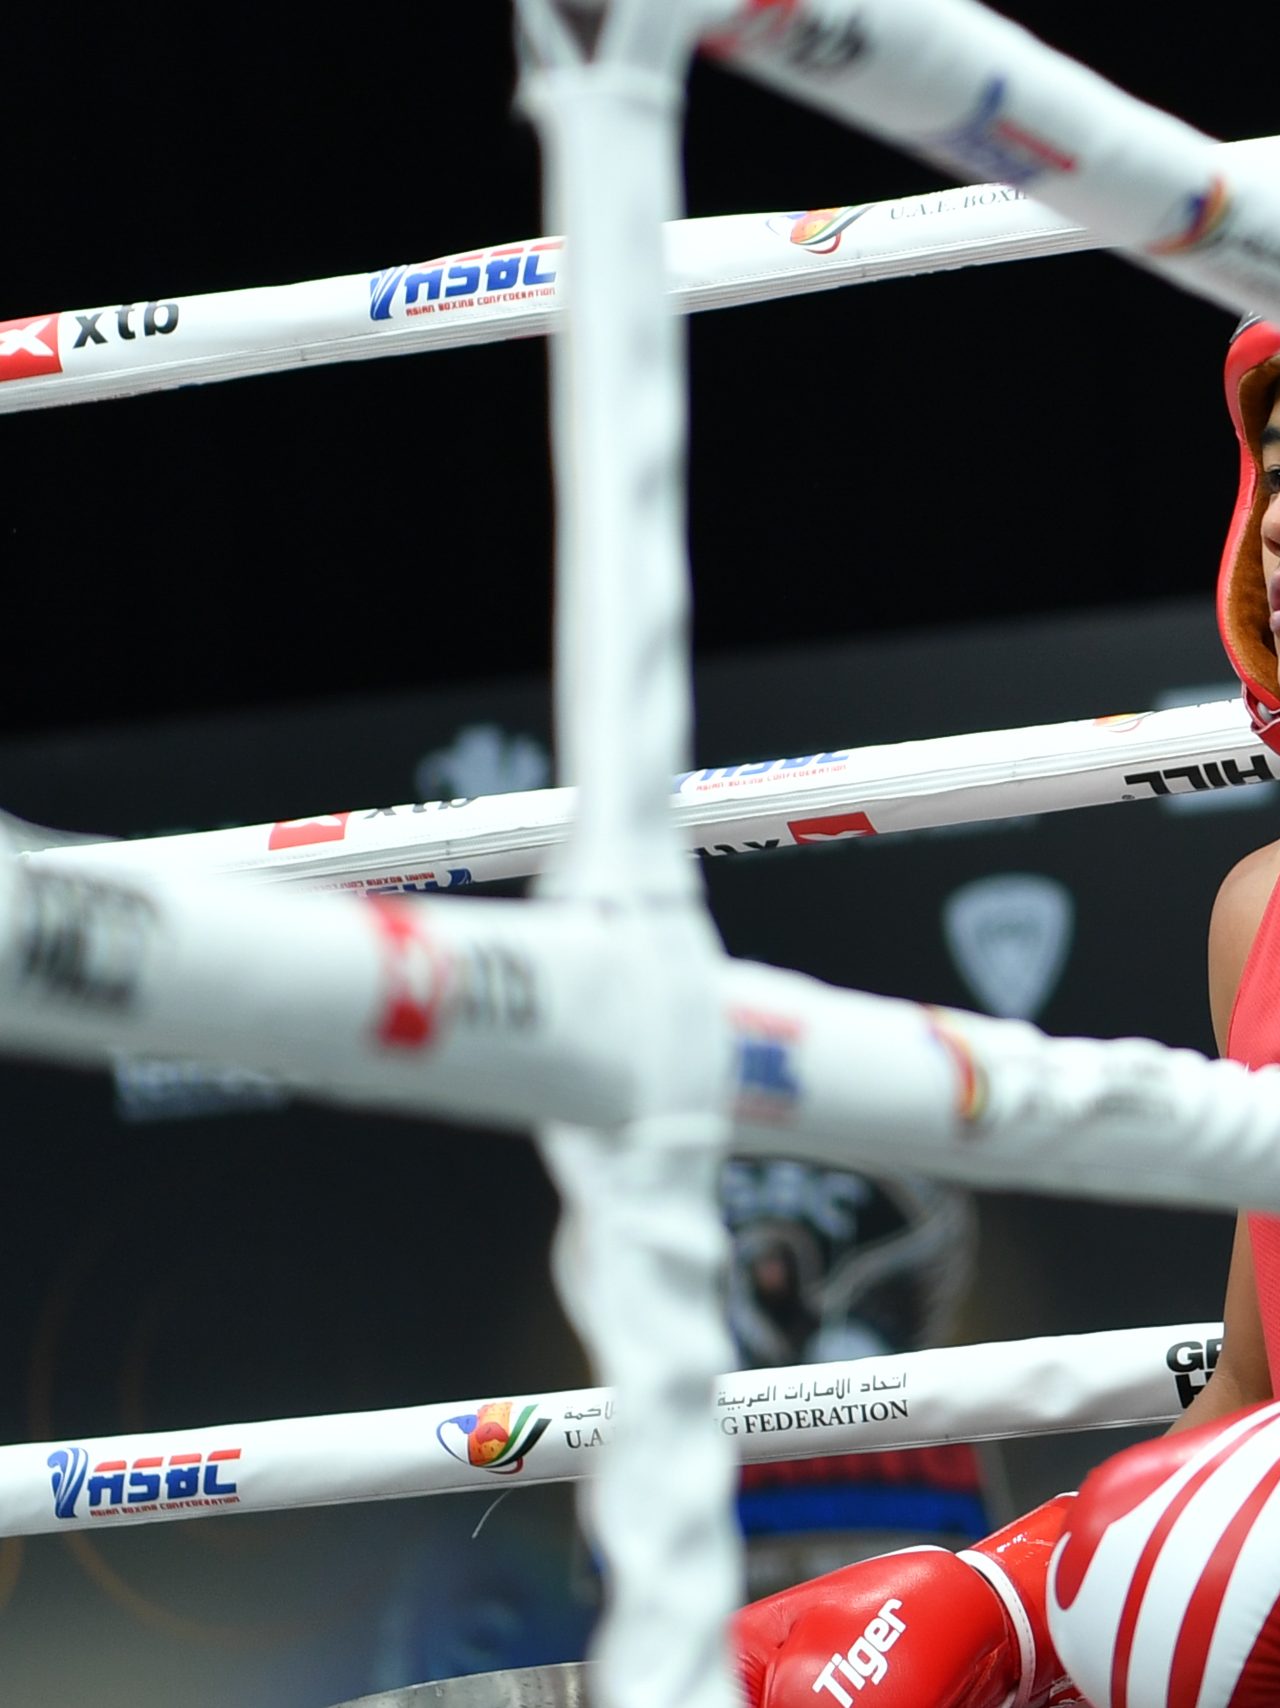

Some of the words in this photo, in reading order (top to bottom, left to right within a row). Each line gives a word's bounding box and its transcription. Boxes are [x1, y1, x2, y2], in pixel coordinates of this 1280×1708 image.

[964, 188, 1028, 209] BOXI
[73, 300, 180, 350] xtb
[1124, 754, 1276, 796] HILL
[743, 1399, 909, 1434] FEDERATION
[87, 1448, 242, 1507] ASBC
[90, 1508, 120, 1518] ASIAN
[122, 1503, 158, 1515] BOXING
[160, 1496, 241, 1508] CONFEDERATION
[812, 1598, 907, 1708] Tiger
